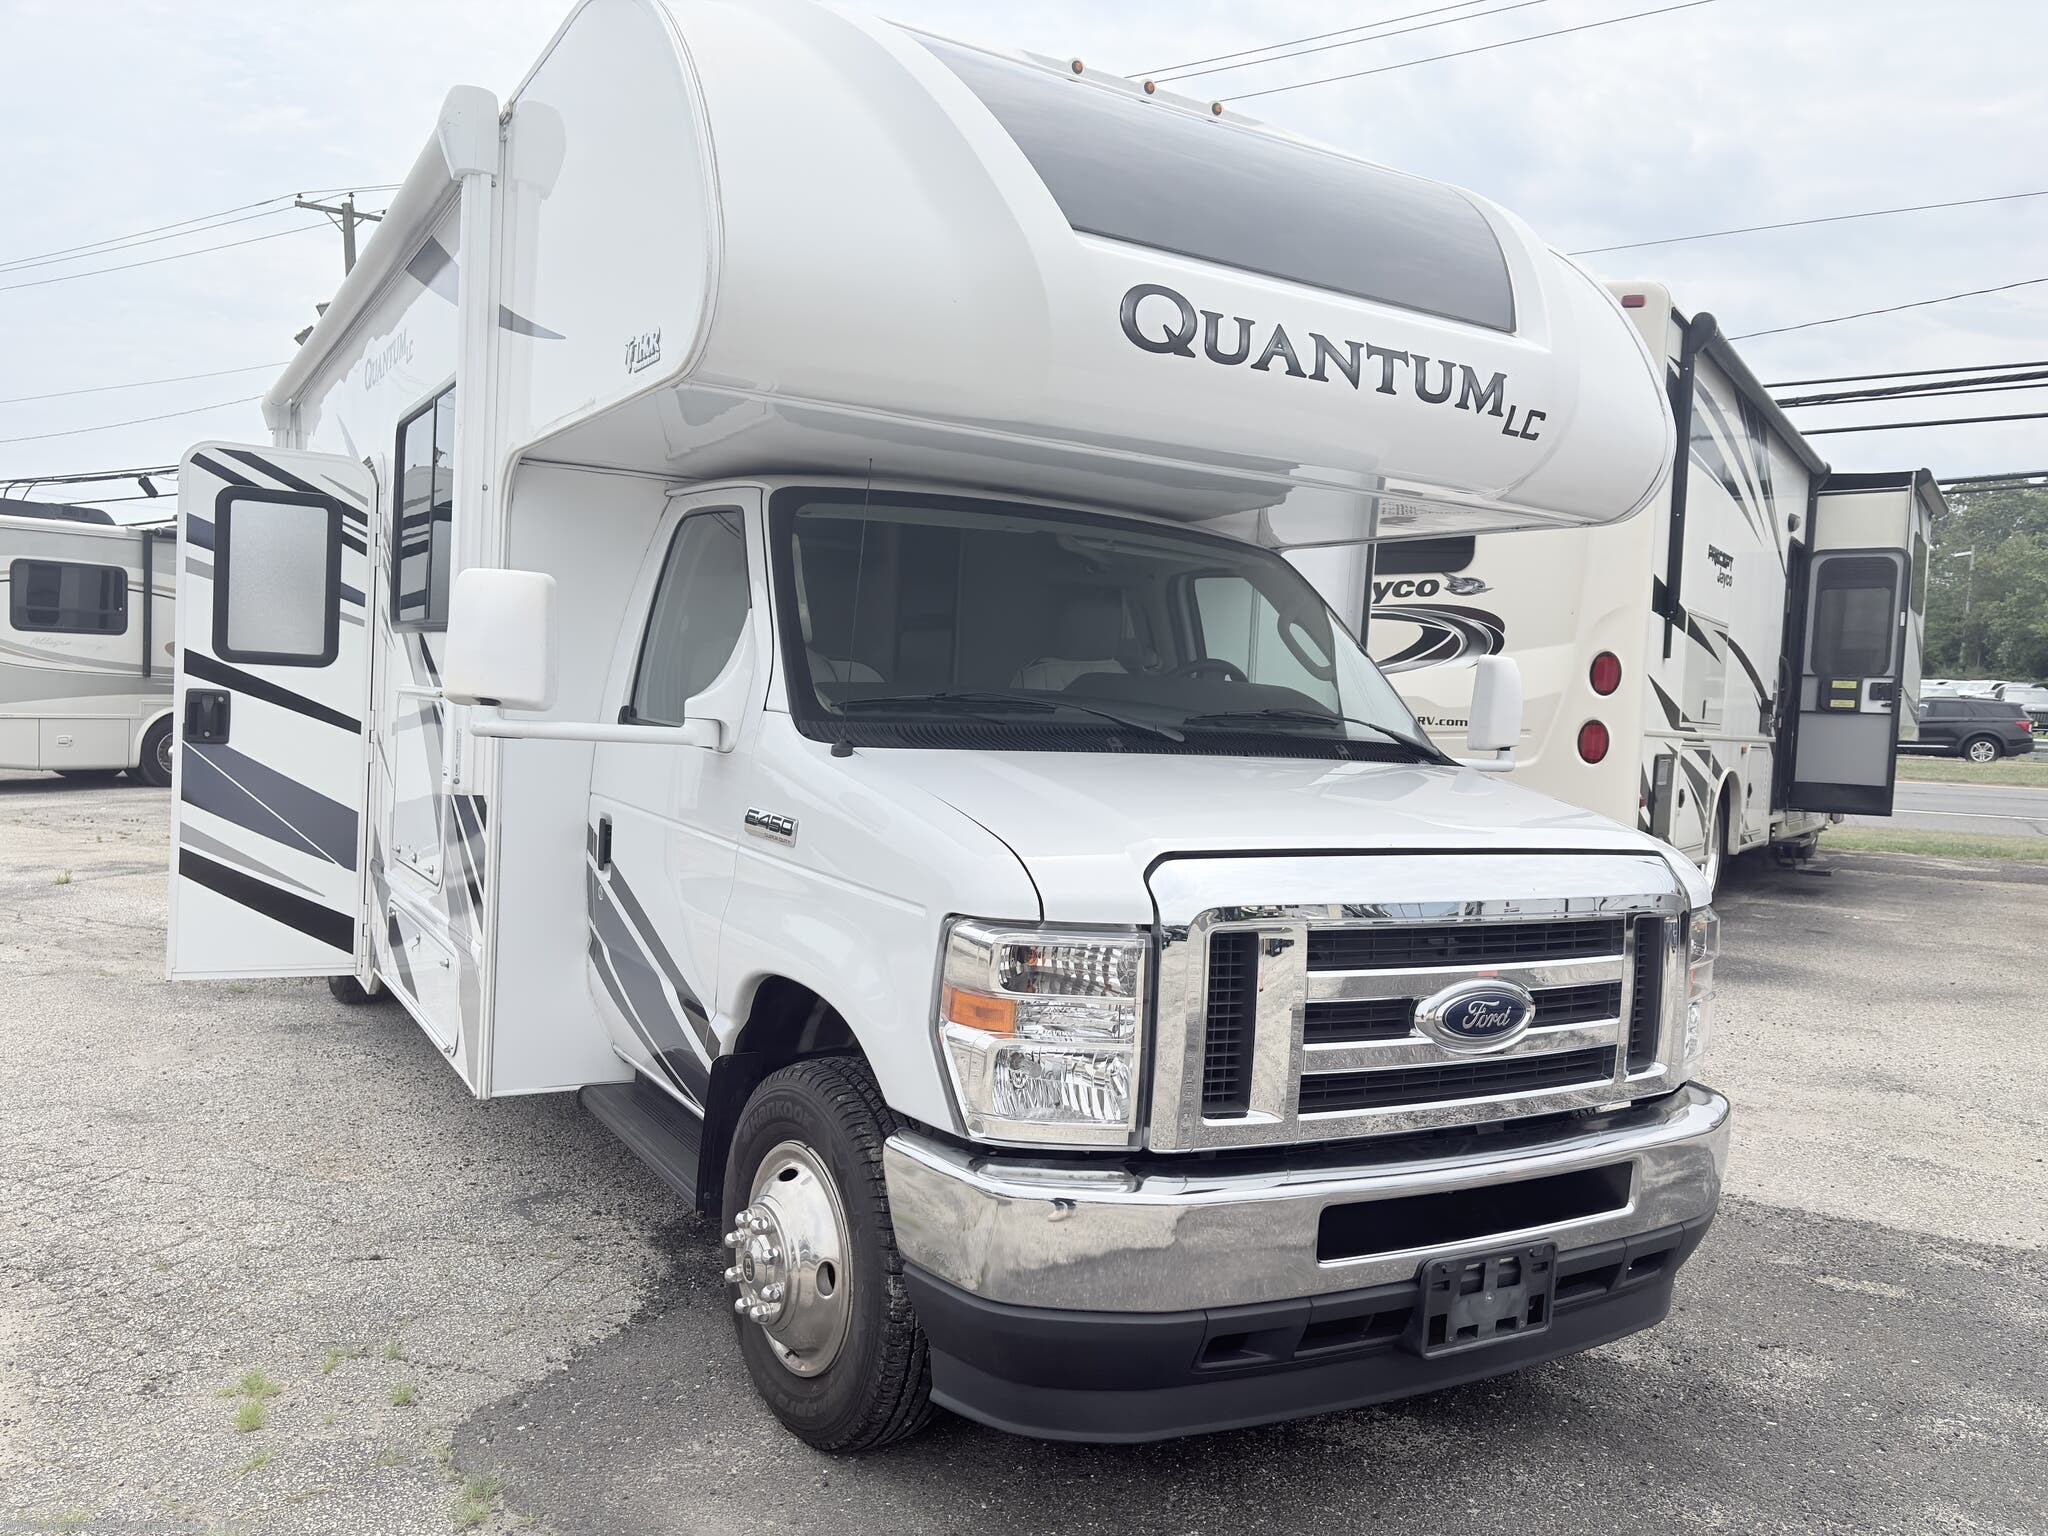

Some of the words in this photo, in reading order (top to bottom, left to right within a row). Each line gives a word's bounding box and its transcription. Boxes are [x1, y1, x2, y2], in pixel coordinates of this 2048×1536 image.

[364, 328, 408, 392] QUANTUM
[1119, 283, 1508, 418] QUANTUM
[1502, 404, 1547, 441] LC
[1462, 1000, 1512, 1030] Ford
